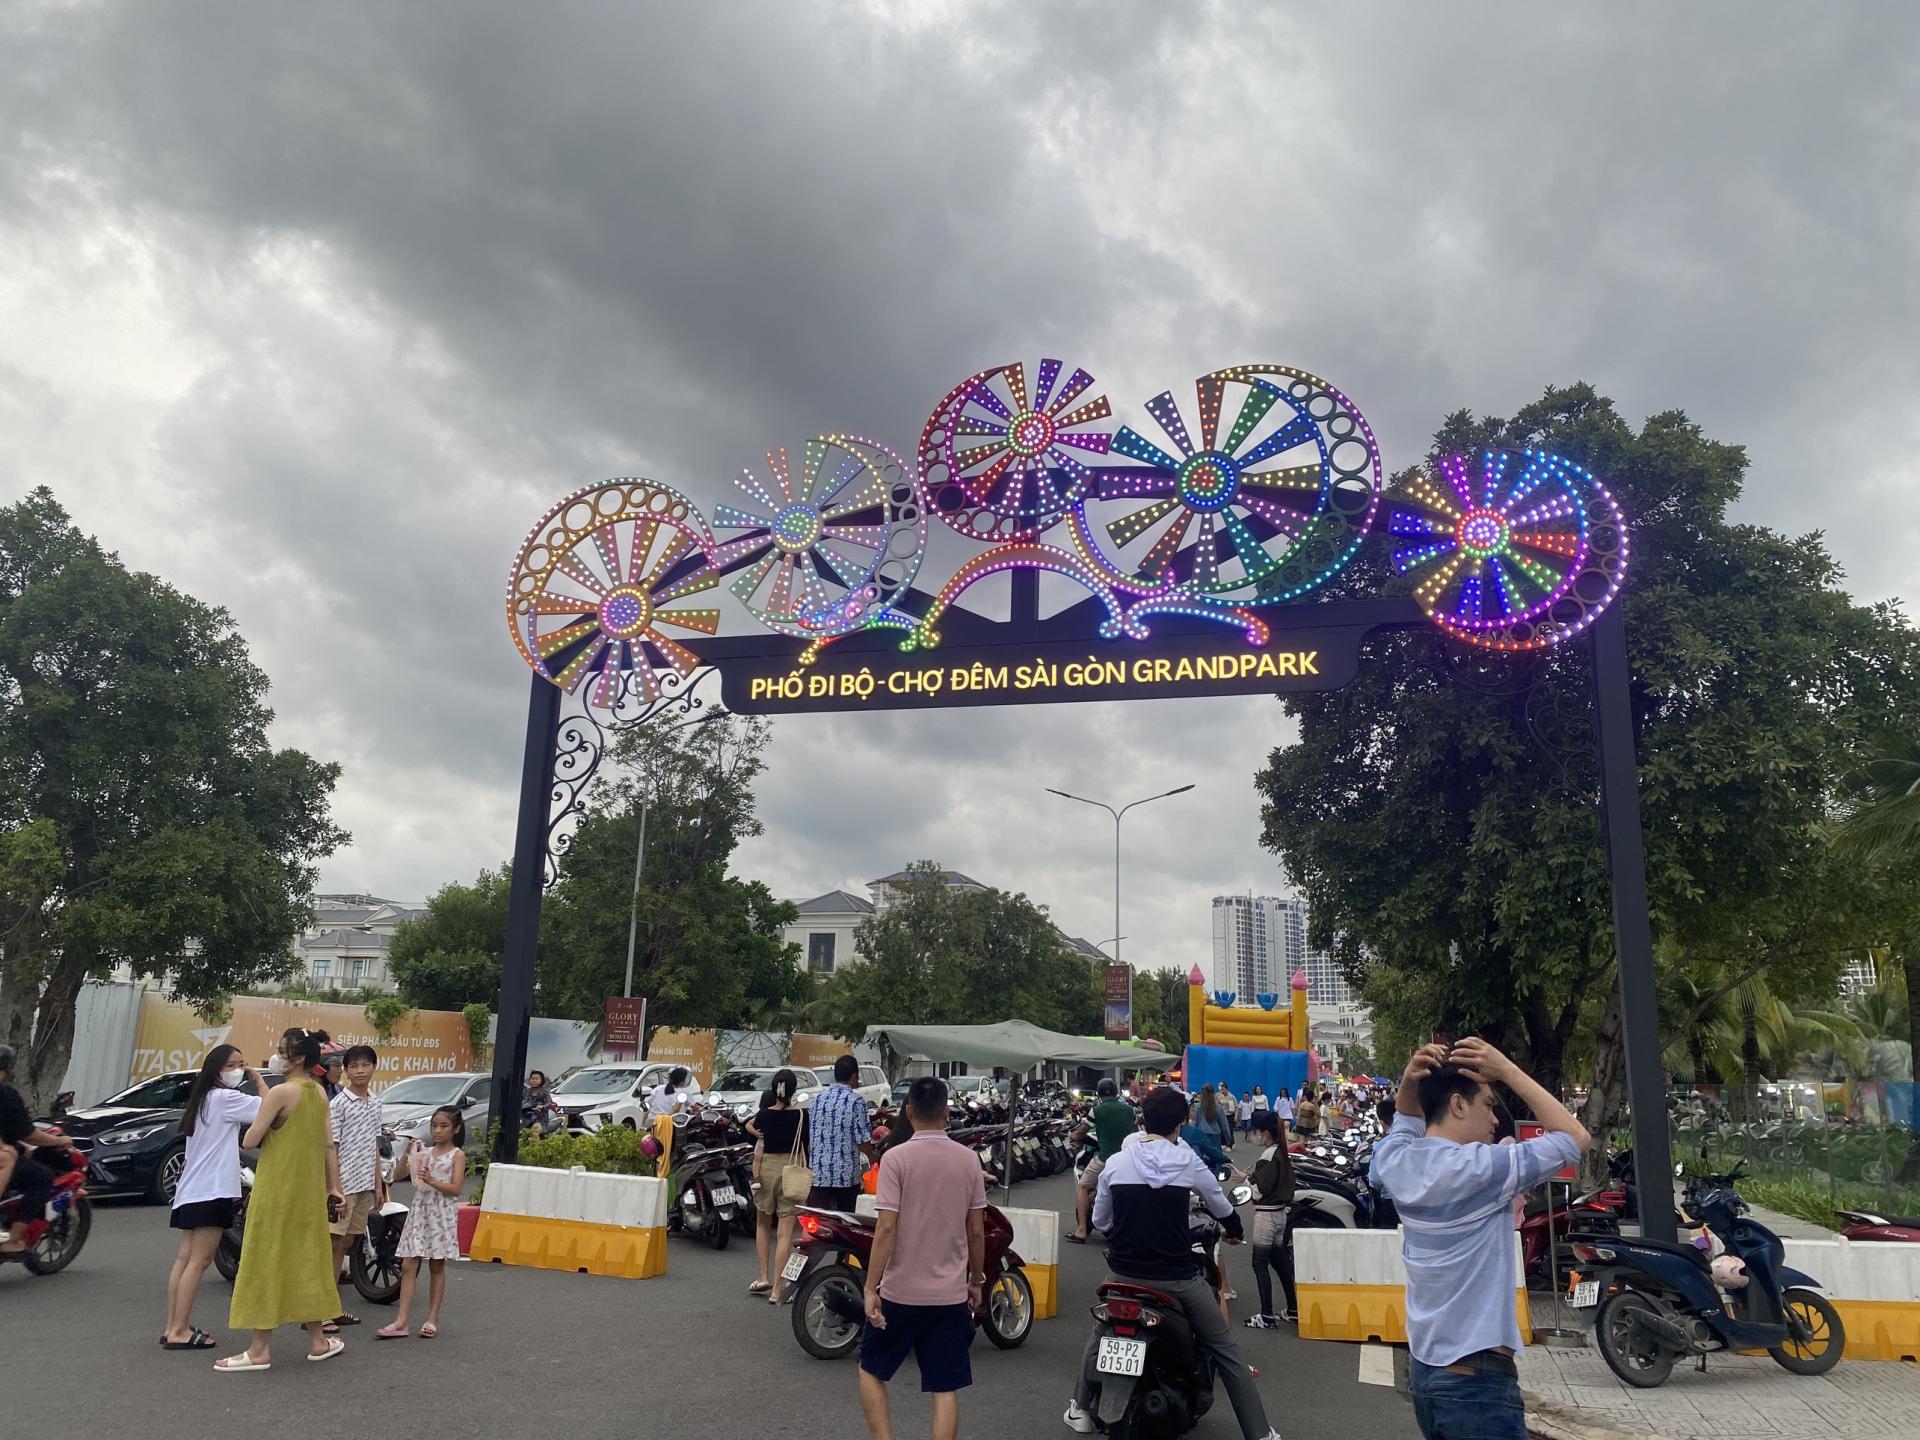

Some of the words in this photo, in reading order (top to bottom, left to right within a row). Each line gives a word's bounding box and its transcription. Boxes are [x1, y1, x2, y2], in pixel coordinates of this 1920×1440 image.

[751, 668, 805, 699] PHỐ
[809, 675, 834, 697] ĐI
[950, 662, 1008, 691] ĐÊM
[1014, 658, 1056, 688] SÀI
[1063, 656, 1126, 686] GÒN
[1132, 651, 1319, 682] GRANDPARK
[608, 1013, 638, 1021] GLORY
[337, 1032, 359, 1045] SIÊU
[403, 1057, 434, 1072] KHAI
[437, 1051, 457, 1072] MỞ
[1107, 1341, 1138, 1357] 59-P2
[1100, 1355, 1139, 1373] 815.01
